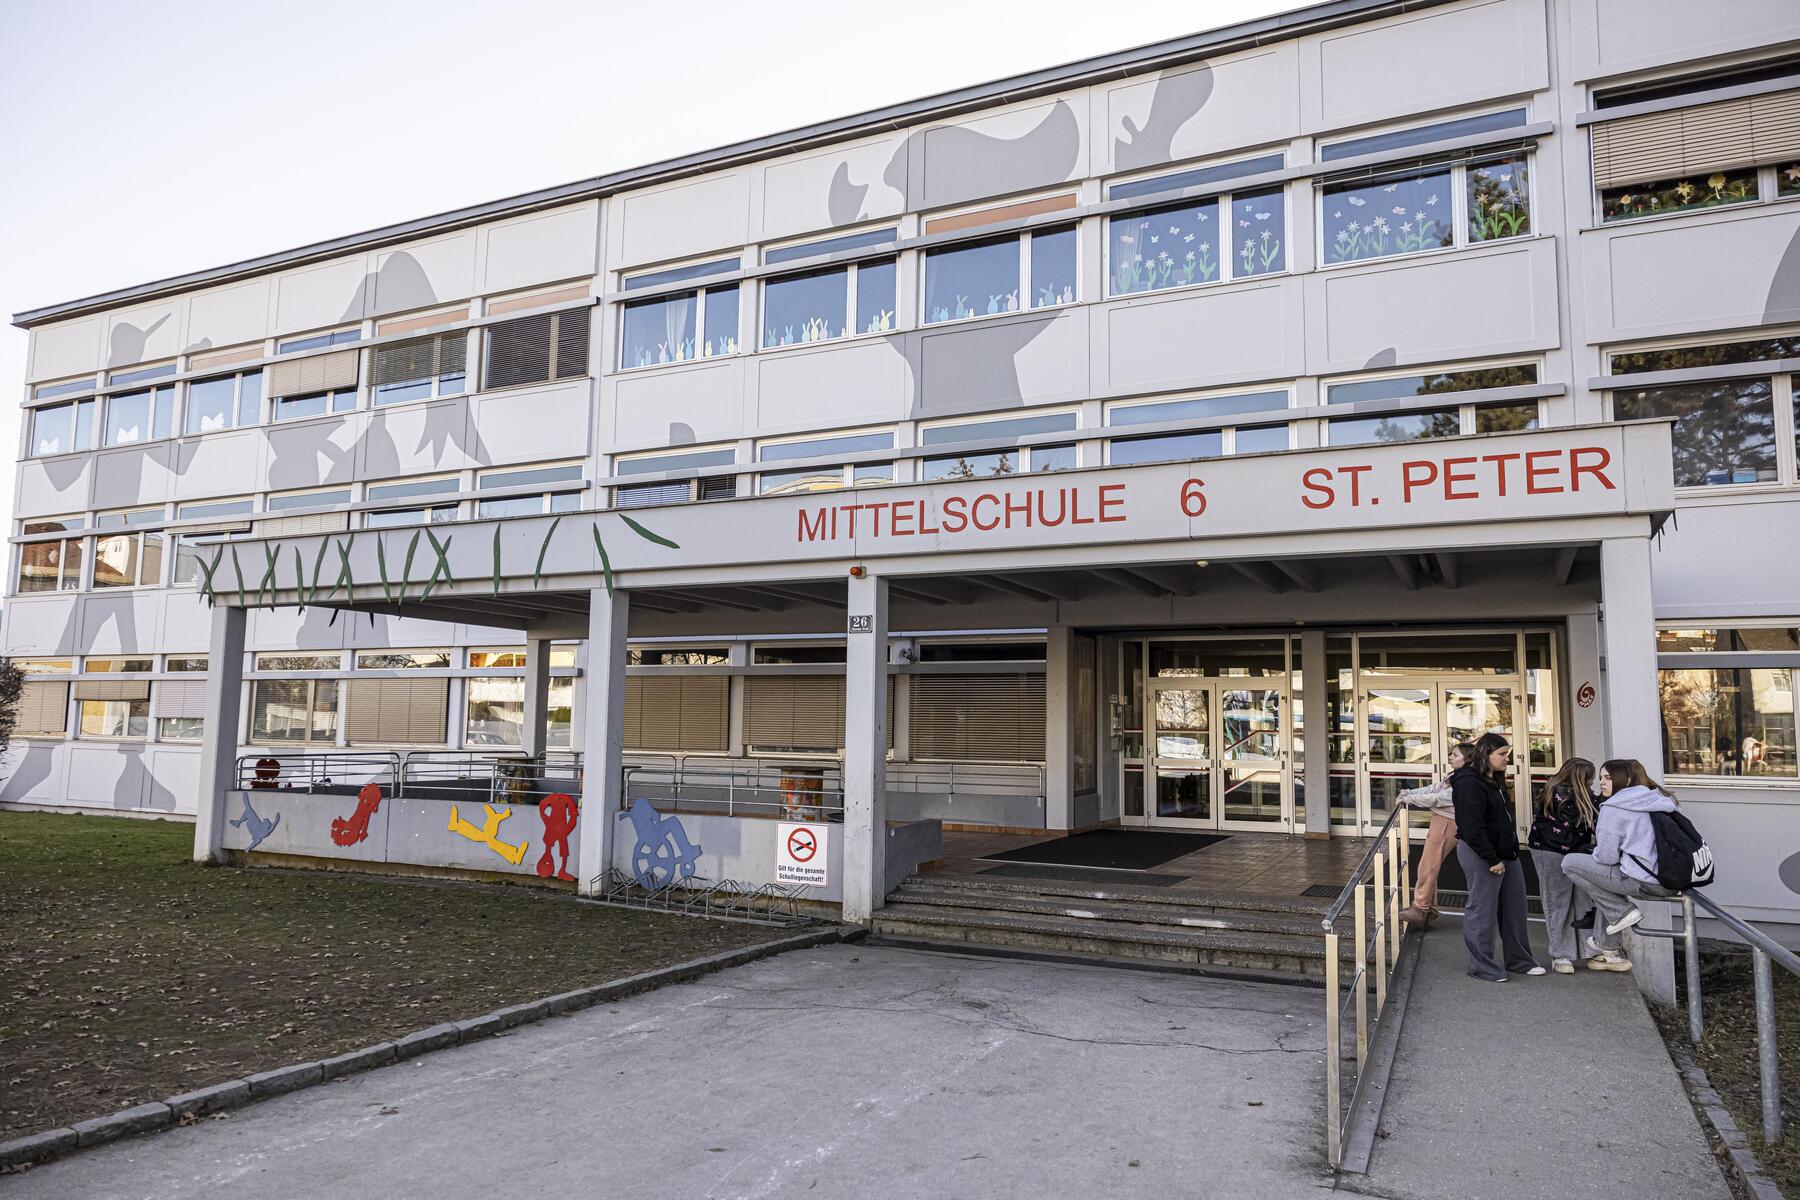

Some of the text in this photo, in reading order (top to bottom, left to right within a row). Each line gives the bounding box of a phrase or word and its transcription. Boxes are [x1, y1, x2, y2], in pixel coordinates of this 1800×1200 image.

[799, 448, 1614, 541] MITTELSCHULE 6 ST. PETER
[853, 616, 867, 627] 26
